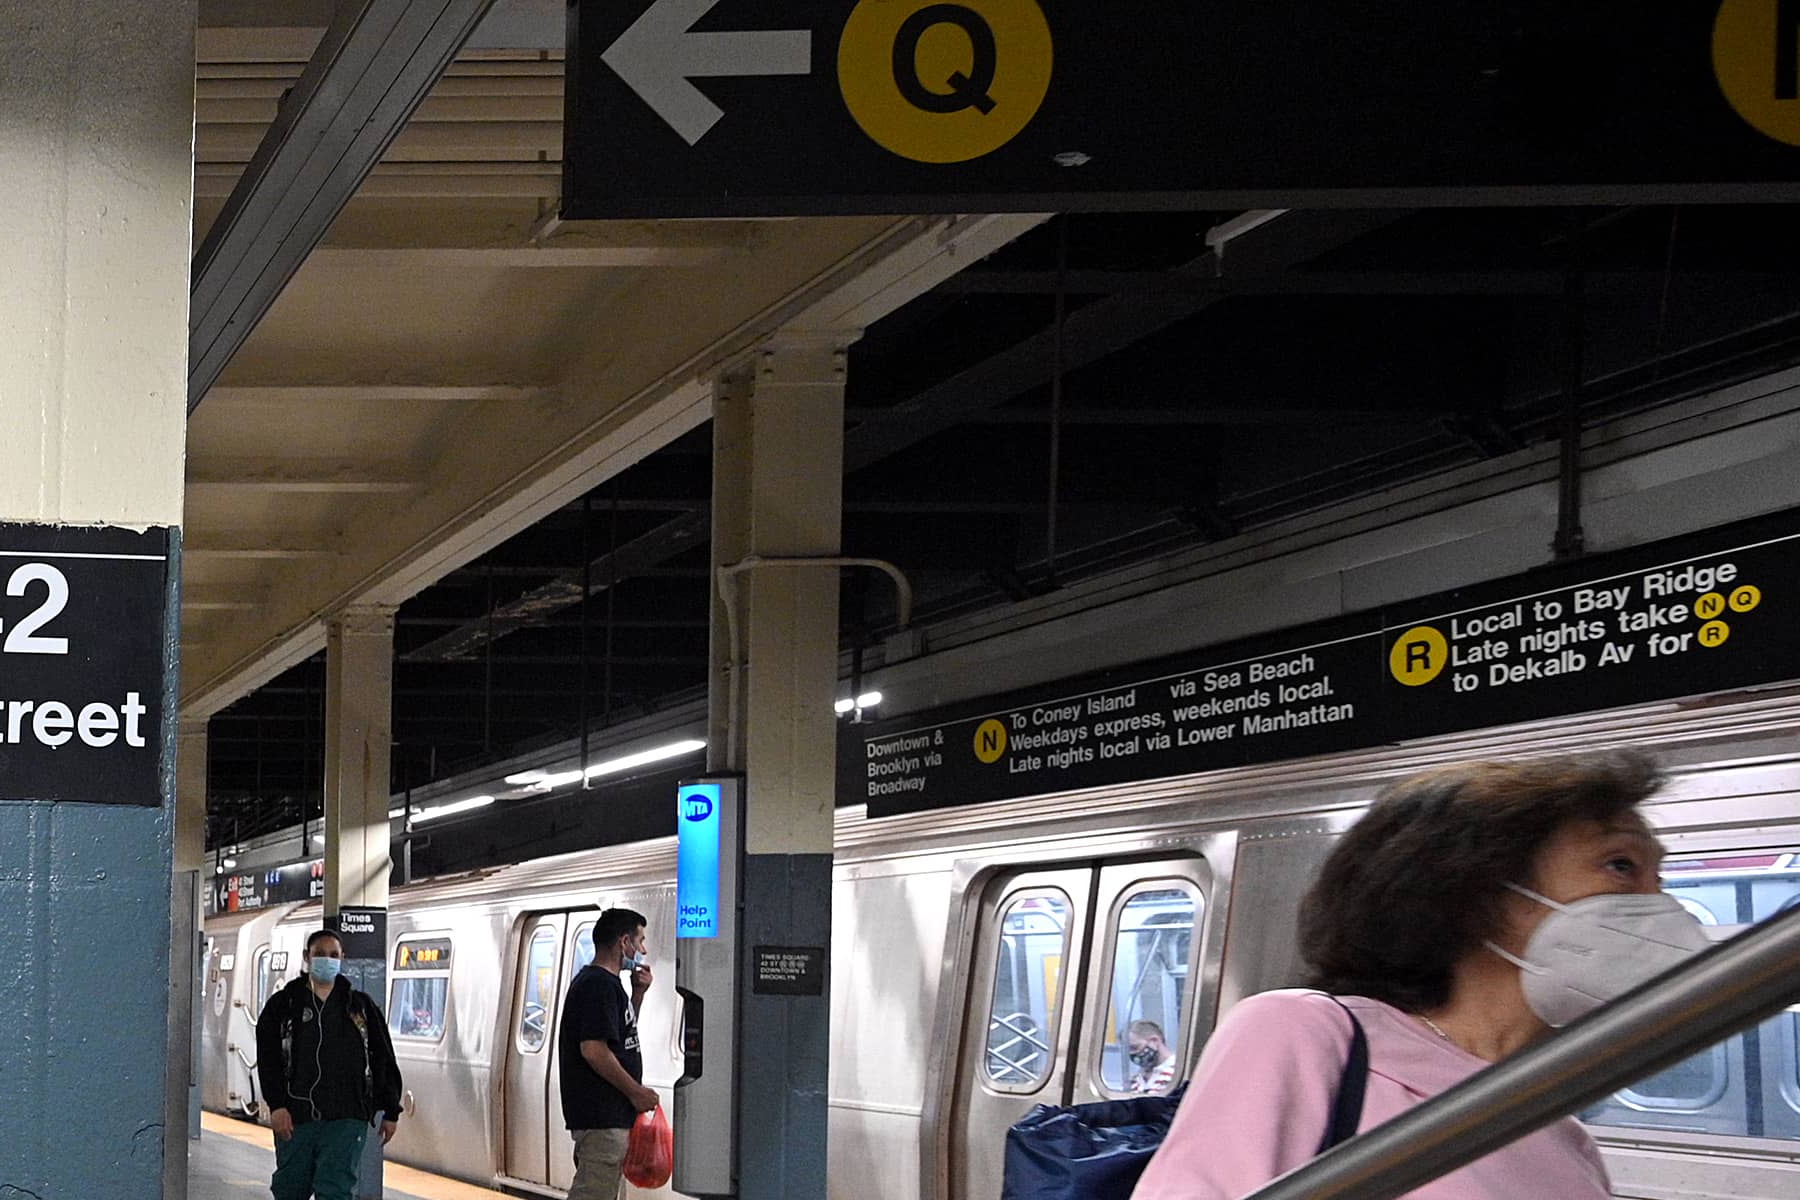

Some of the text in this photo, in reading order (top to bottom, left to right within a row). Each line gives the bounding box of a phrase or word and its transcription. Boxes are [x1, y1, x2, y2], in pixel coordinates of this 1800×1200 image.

[890, 2, 999, 115] Q
[1451, 563, 1738, 640] Local to Bay Ridge
[1452, 591, 1752, 667] Late nights take N Q
[1405, 640, 1431, 673] R
[1452, 627, 1720, 693] to Dekalb Av for R
[1010, 653, 1314, 729] To Coney Island via Sea Beach
[1010, 675, 1334, 751] Weekdays express, weekends local.
[867, 729, 944, 758] Downtown &
[983, 730, 997, 752] N
[1009, 703, 1354, 773] Late nights local via Lower Manhattan
[867, 751, 942, 777] Brooklyn via
[867, 776, 926, 796] Broadway
[341, 913, 371, 923] Times
[680, 905, 708, 917] Help
[680, 918, 711, 928] Point
[341, 923, 375, 934] Square
